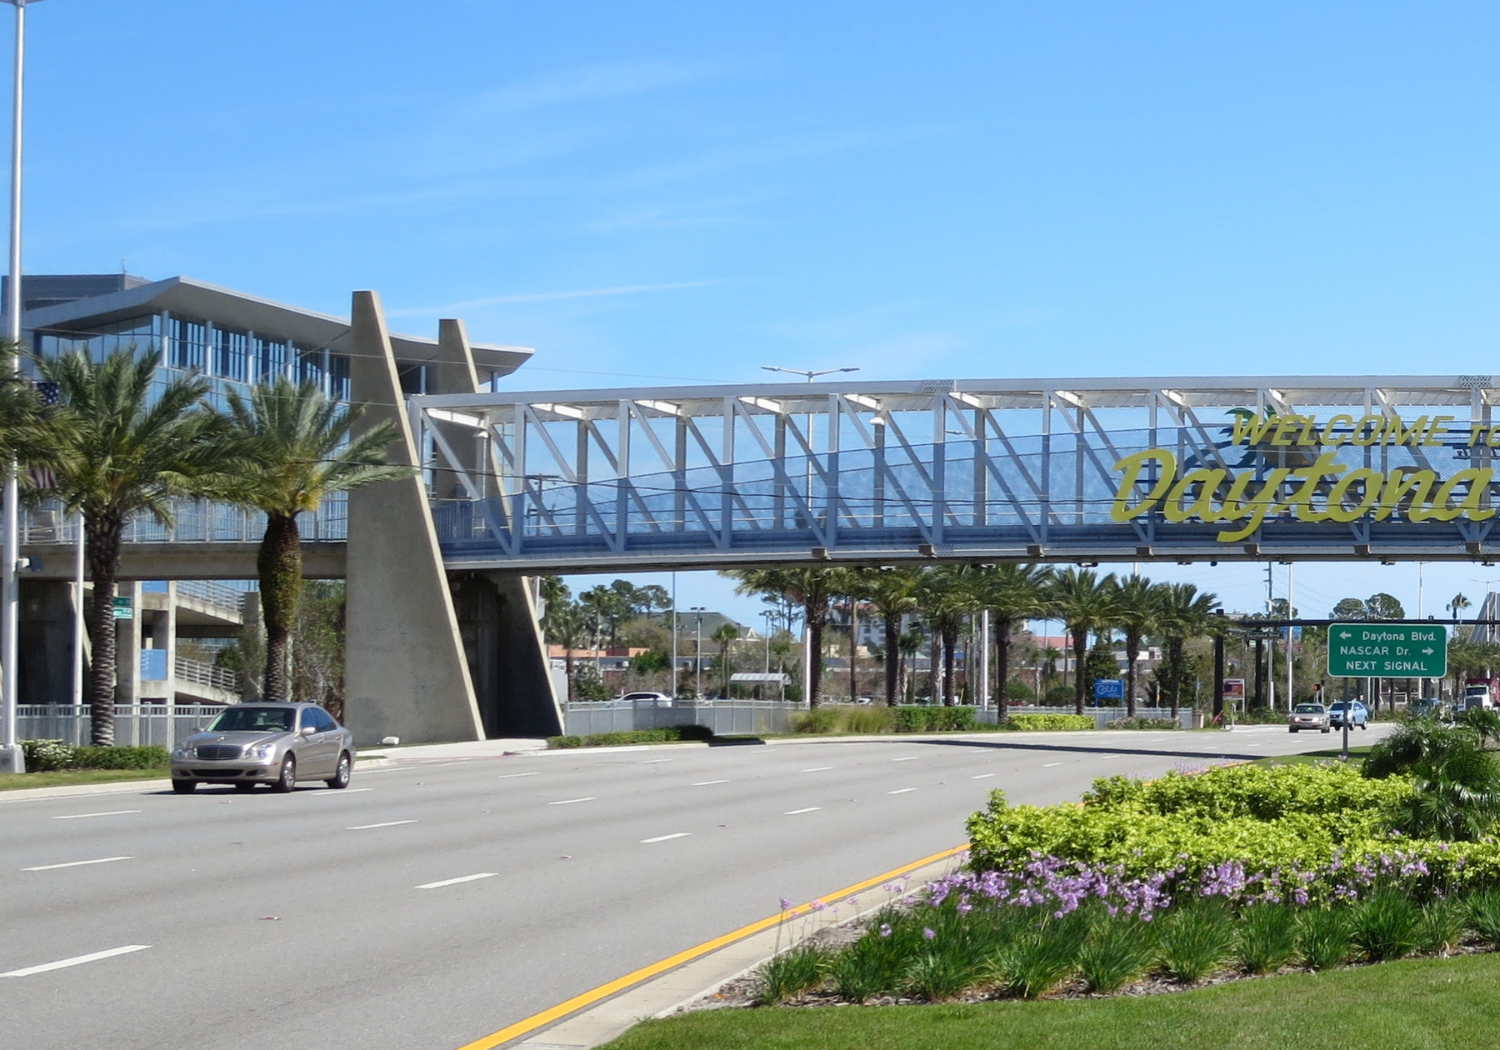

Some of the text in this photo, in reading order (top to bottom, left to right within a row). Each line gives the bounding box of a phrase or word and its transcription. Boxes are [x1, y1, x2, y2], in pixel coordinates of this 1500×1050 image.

[1231, 413, 1455, 447] WELCOME
[1110, 447, 1495, 543] Daytona
[1362, 631, 1437, 643] Daytona Blvd.
[1340, 646, 1389, 656] NASCAR
[1346, 661, 1427, 671] NEXT SIGNAL
